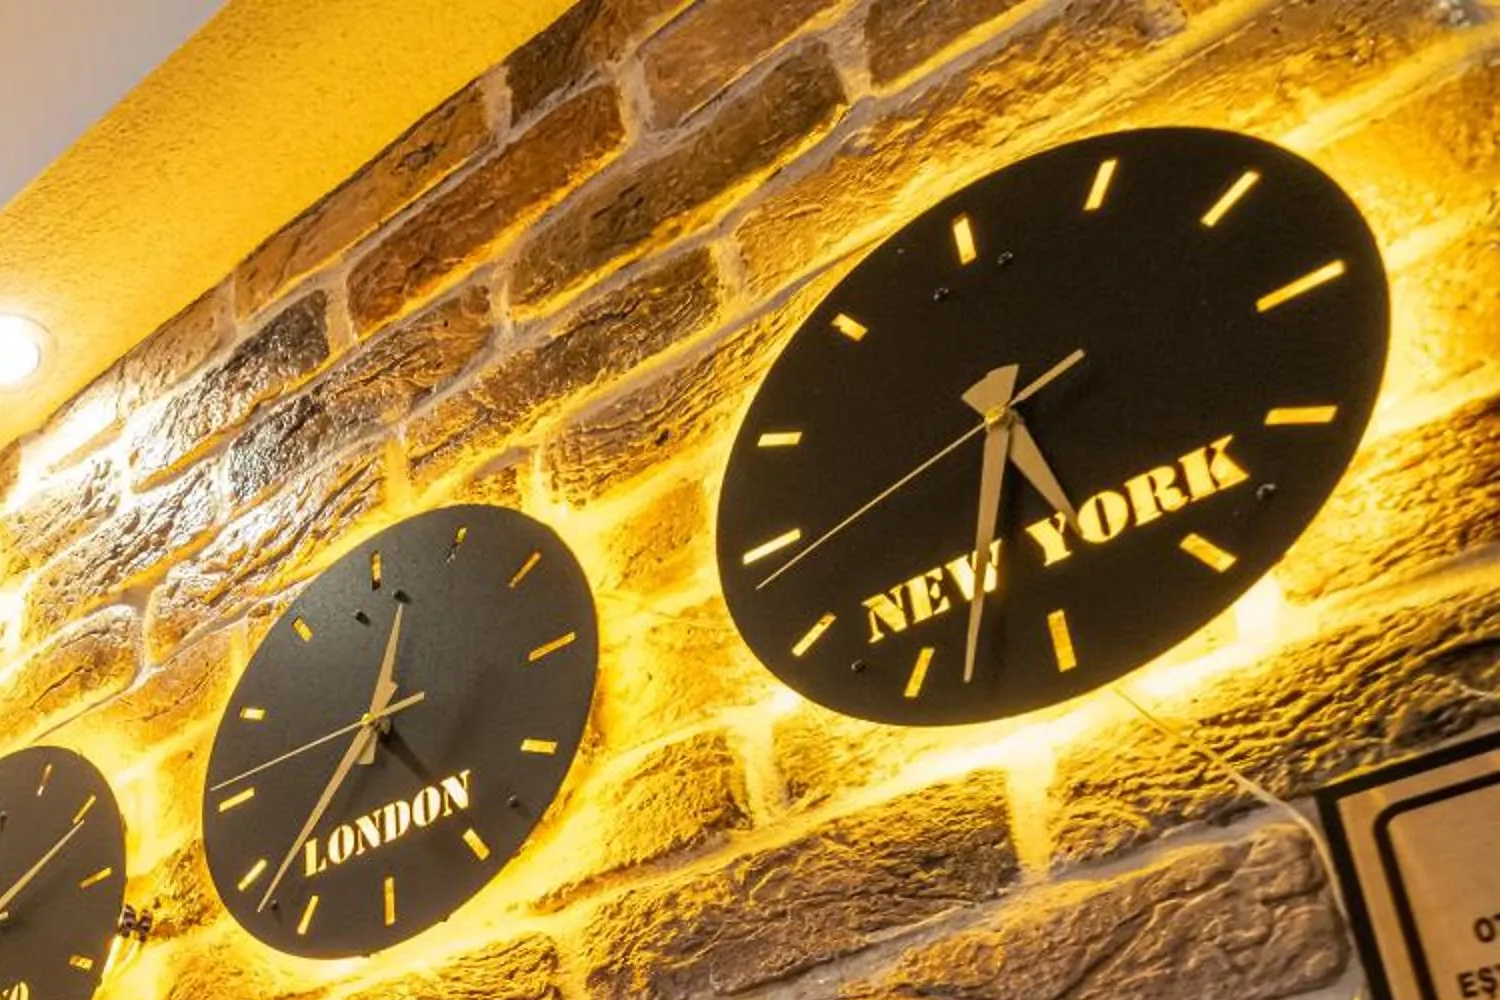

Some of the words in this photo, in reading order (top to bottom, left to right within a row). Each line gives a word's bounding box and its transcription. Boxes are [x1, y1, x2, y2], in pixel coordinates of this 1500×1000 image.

[861, 537, 1002, 643] NEW
[1025, 433, 1251, 568] YORK
[303, 769, 473, 877] LONDON
